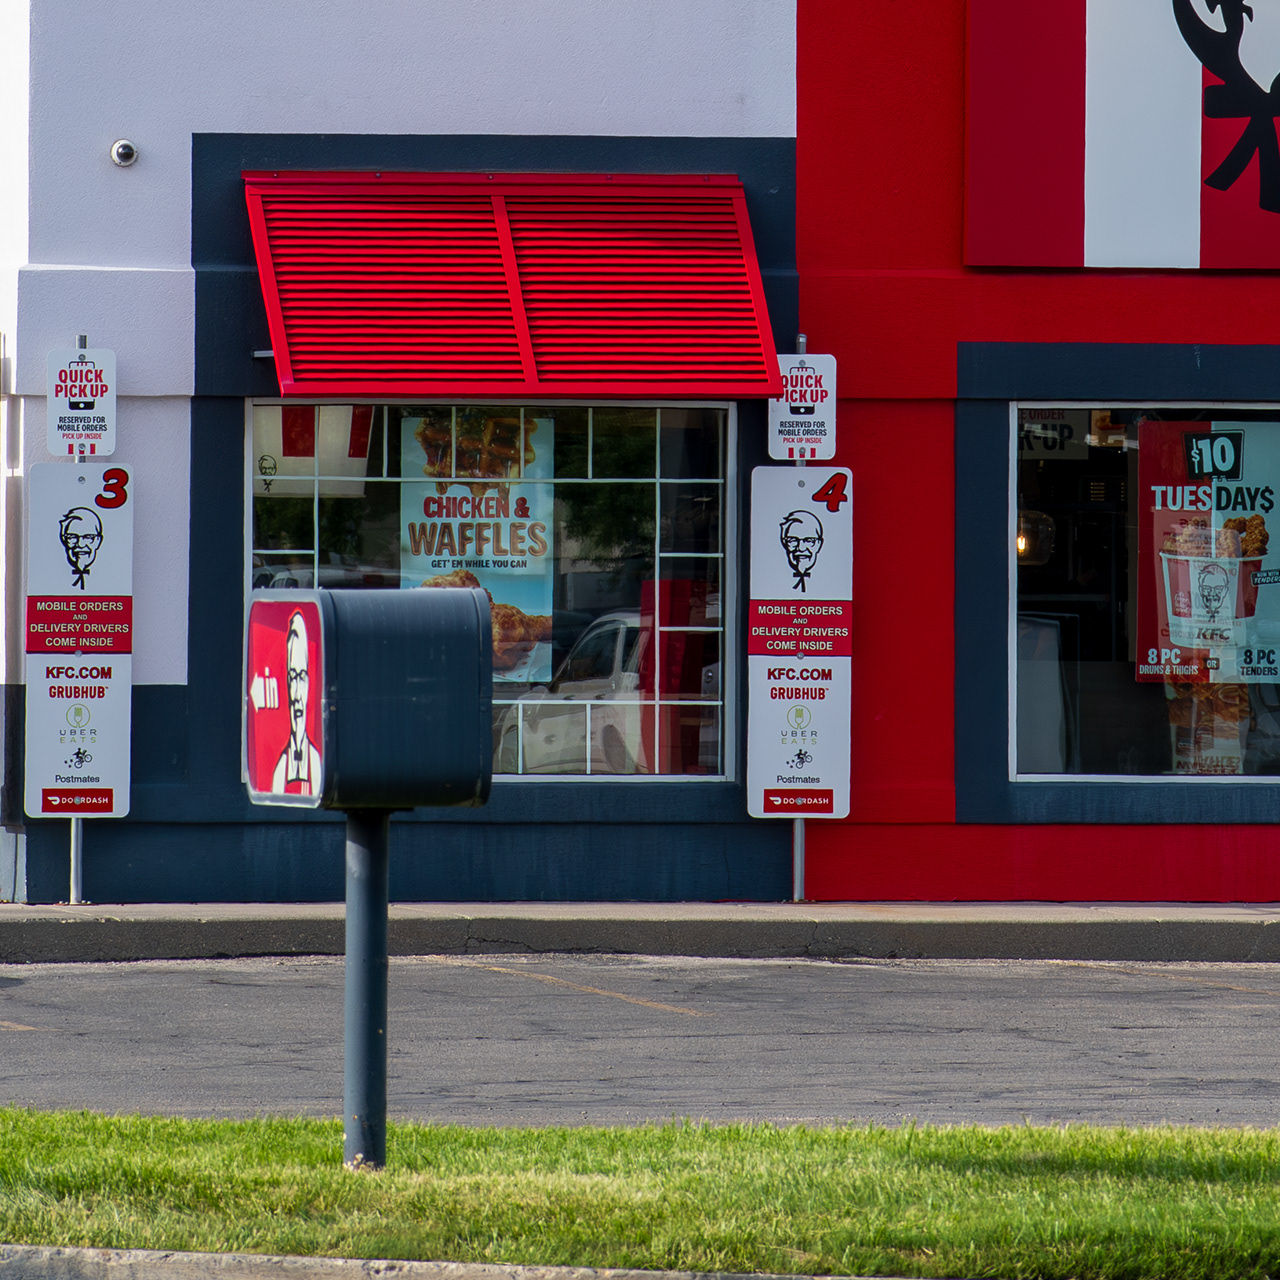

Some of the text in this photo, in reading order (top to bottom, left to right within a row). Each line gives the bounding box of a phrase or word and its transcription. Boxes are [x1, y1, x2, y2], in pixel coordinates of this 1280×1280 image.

[58, 369, 103, 384] QUICK
[55, 384, 108, 398] PICK UP
[810, 389, 828, 403] UP
[59, 416, 106, 424] RESERVED FOR
[57, 424, 107, 432] MOBILE ORDERS
[1191, 436, 1235, 474] $10
[95, 468, 129, 509] 3
[812, 471, 848, 512] 4
[423, 496, 531, 519] CHICKEN &
[408, 521, 547, 556] WAFFLES
[465, 559, 490, 569] WHILE
[492, 559, 508, 569] YOU
[510, 559, 527, 569] CAN
[36, 602, 123, 611] MOBILE ORDERS
[758, 606, 842, 615] MOBILE ORDERS
[30, 623, 129, 633] DELIVERY DRIVERS
[752, 627, 848, 637] DELIVERY DRIVERS
[45, 637, 113, 646] COME INSIDE
[766, 641, 833, 650] COME INSIDE
[1147, 649, 1181, 664] 8 PC
[1243, 649, 1276, 665] 8 PC
[1139, 664, 1198, 675] DRUMS & THIGHS
[1206, 660, 1217, 669] OR
[45, 666, 112, 679] KFC.COM
[767, 668, 832, 680] KFC.COM
[1240, 665, 1278, 676] TENDERS
[264, 666, 279, 709] in
[55, 774, 100, 783] Postmates
[777, 775, 820, 784] Postmates
